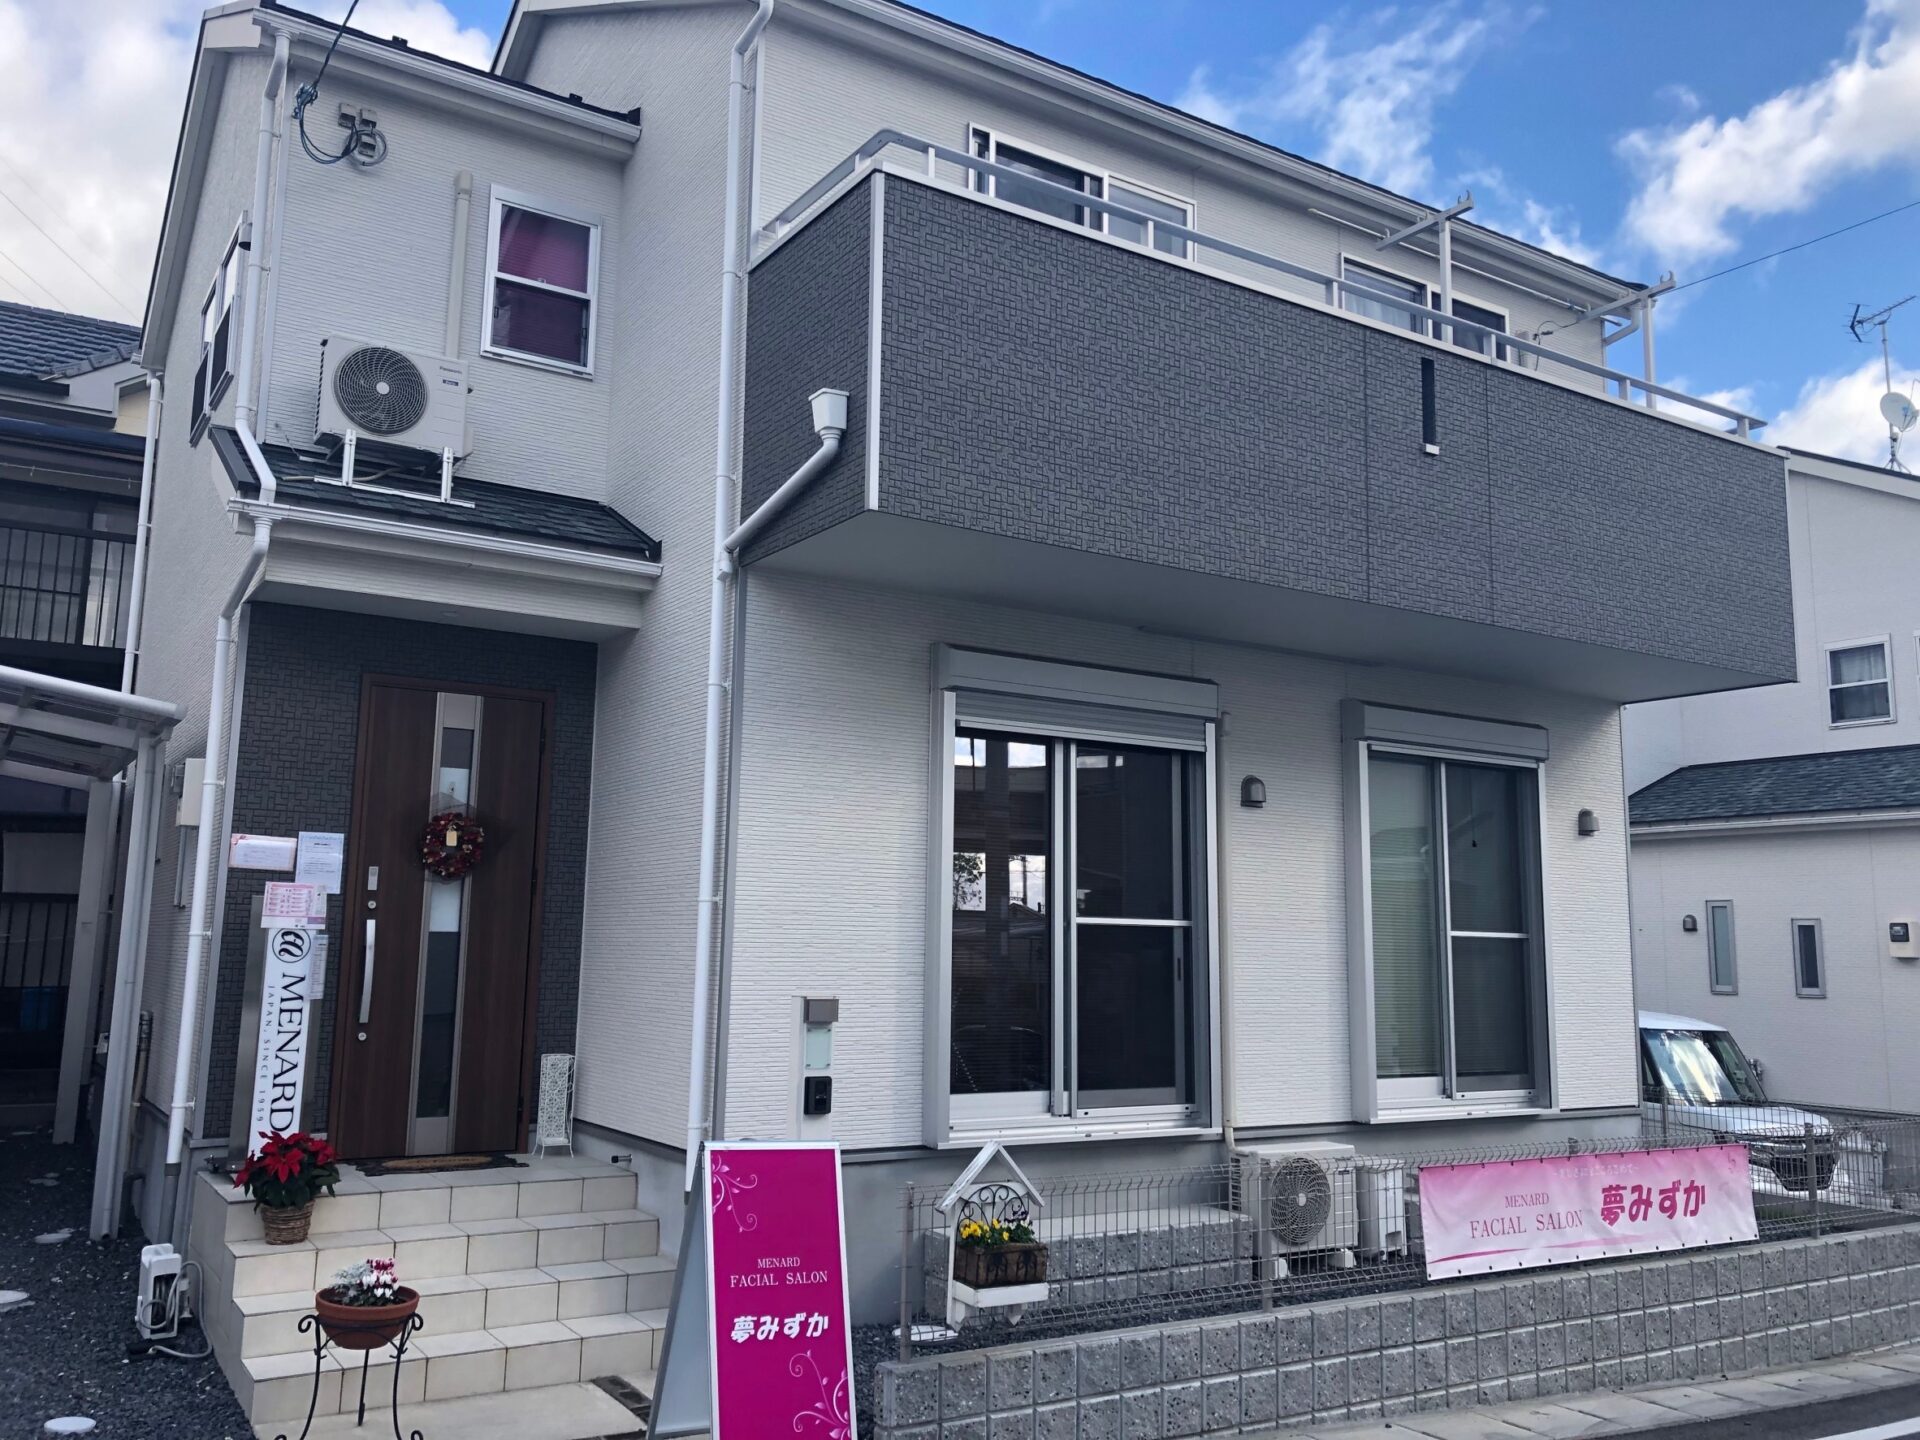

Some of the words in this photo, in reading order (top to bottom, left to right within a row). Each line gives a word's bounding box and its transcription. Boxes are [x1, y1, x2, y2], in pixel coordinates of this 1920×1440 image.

[260, 1039, 271, 1078] SINCE
[269, 972, 306, 1132] MENARD
[256, 1090, 266, 1121] 1959
[1505, 1192, 1550, 1208] MENARD
[1600, 1180, 1706, 1227] 夢みずか
[1470, 1216, 1527, 1239] FACIAL
[1535, 1210, 1583, 1231] SALON
[757, 1257, 801, 1269] MENARD
[730, 1274, 779, 1288] FACIAL
[786, 1270, 828, 1284] SALON
[730, 1312, 829, 1343] 夢みずか
